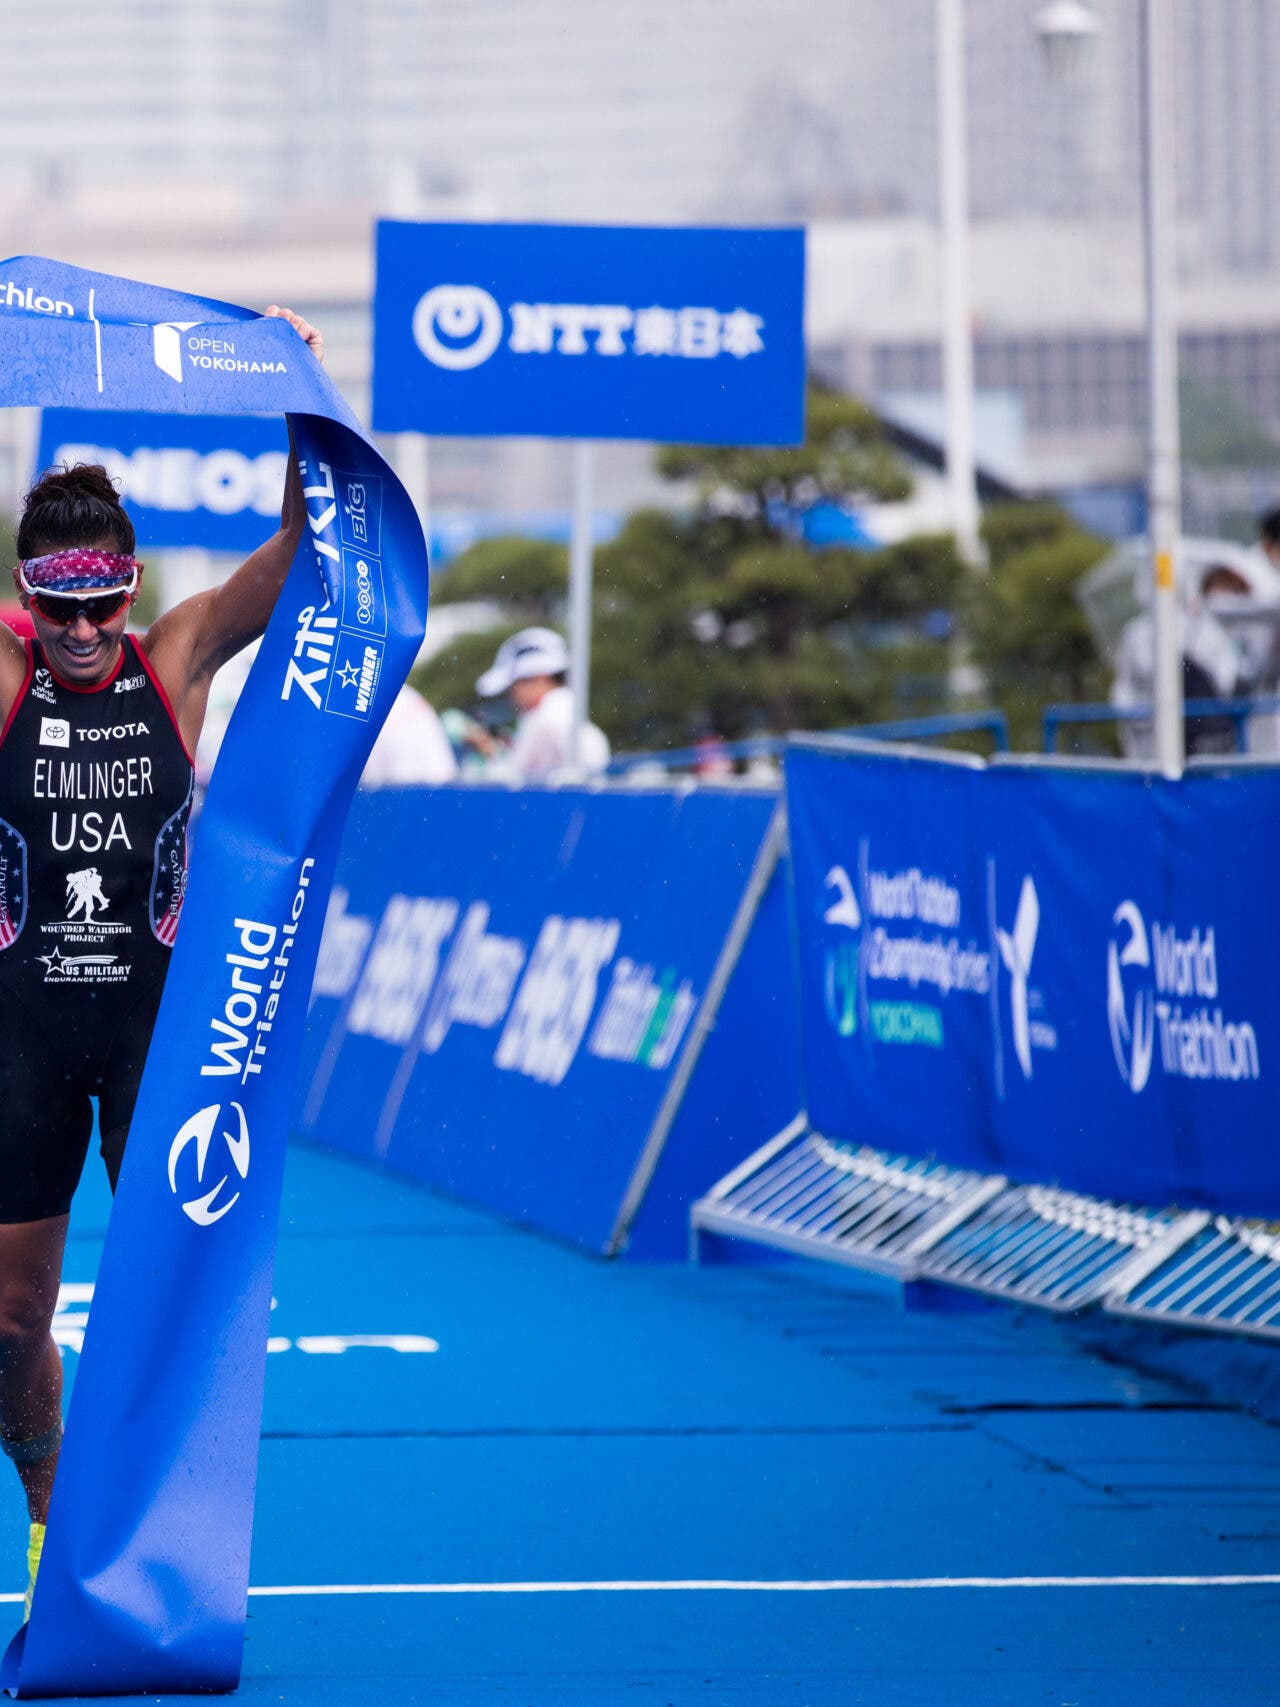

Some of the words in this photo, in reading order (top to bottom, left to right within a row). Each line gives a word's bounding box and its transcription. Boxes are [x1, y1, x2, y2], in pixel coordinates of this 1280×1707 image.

[188, 337, 235, 355] OPEN
[189, 355, 287, 373] YOKOHAMA
[355, 646, 378, 713] WINNER
[76, 722, 150, 741] TOYOTA
[34, 756, 153, 800] ELMLINGER
[51, 811, 132, 852] USA
[40, 924, 85, 934] WOUNDED
[88, 925, 132, 935] WARRIOR
[64, 935, 105, 943] PROJECT
[65, 966, 79, 976] US
[84, 965, 132, 976] MILITARY
[241, 858, 316, 1085] Triathlon
[1151, 921, 1218, 999] World
[96, 975, 128, 983] SPORTS
[200, 918, 277, 1077] World
[1155, 1001, 1261, 1081] Triathlon
